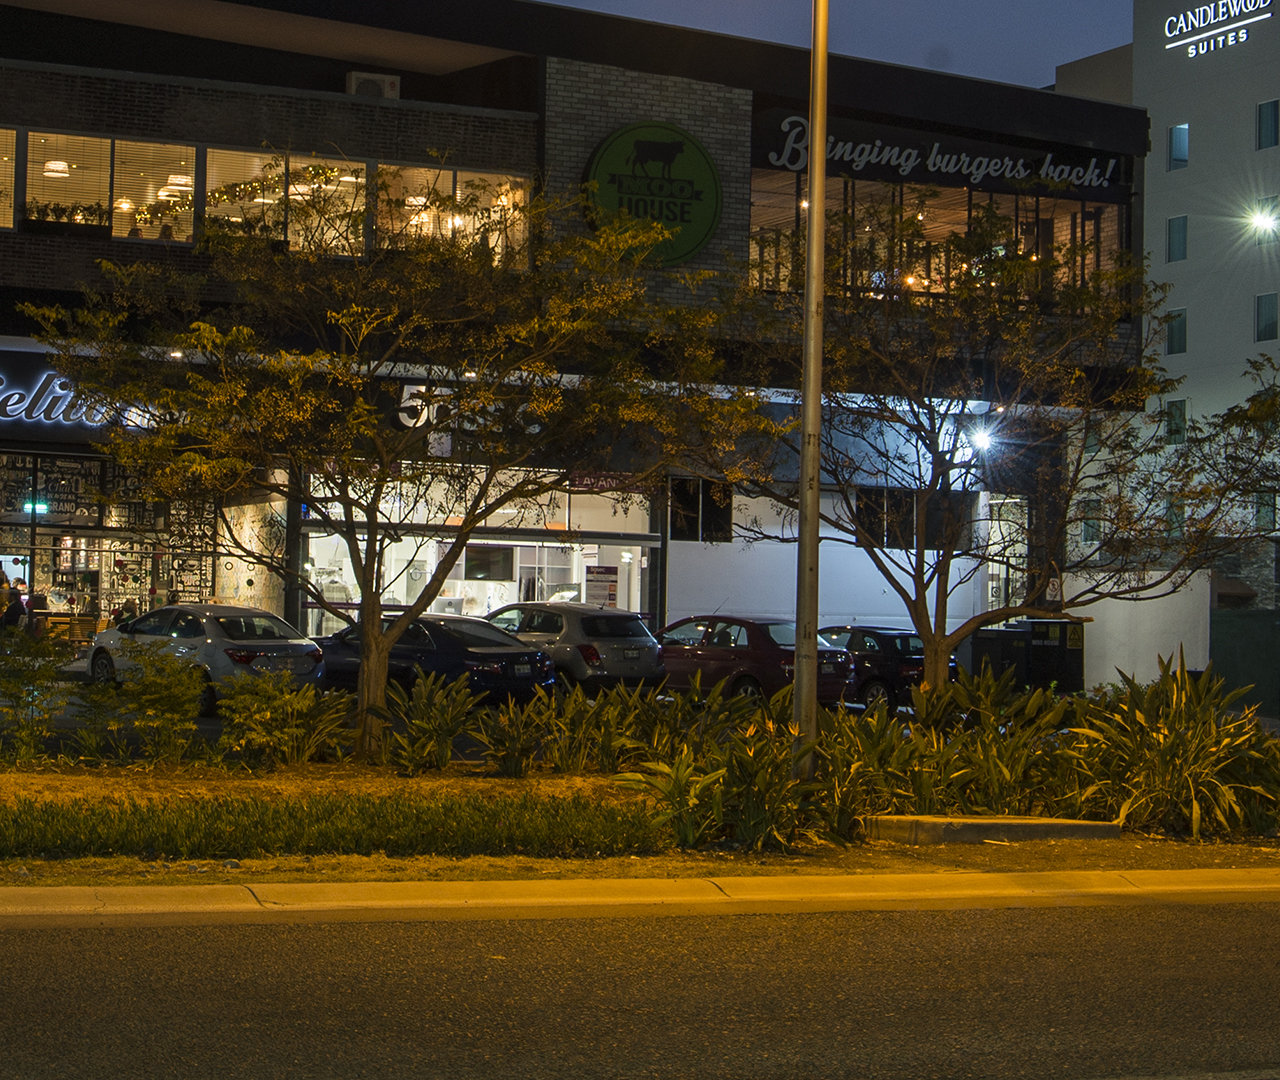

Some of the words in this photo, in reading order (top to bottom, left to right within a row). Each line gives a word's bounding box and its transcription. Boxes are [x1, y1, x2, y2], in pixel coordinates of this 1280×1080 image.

[1187, 29, 1248, 58] SUITES
[768, 115, 921, 176] Binging
[926, 142, 1031, 184] burgers
[1039, 153, 1118, 188] back!
[619, 176, 693, 199] MOO
